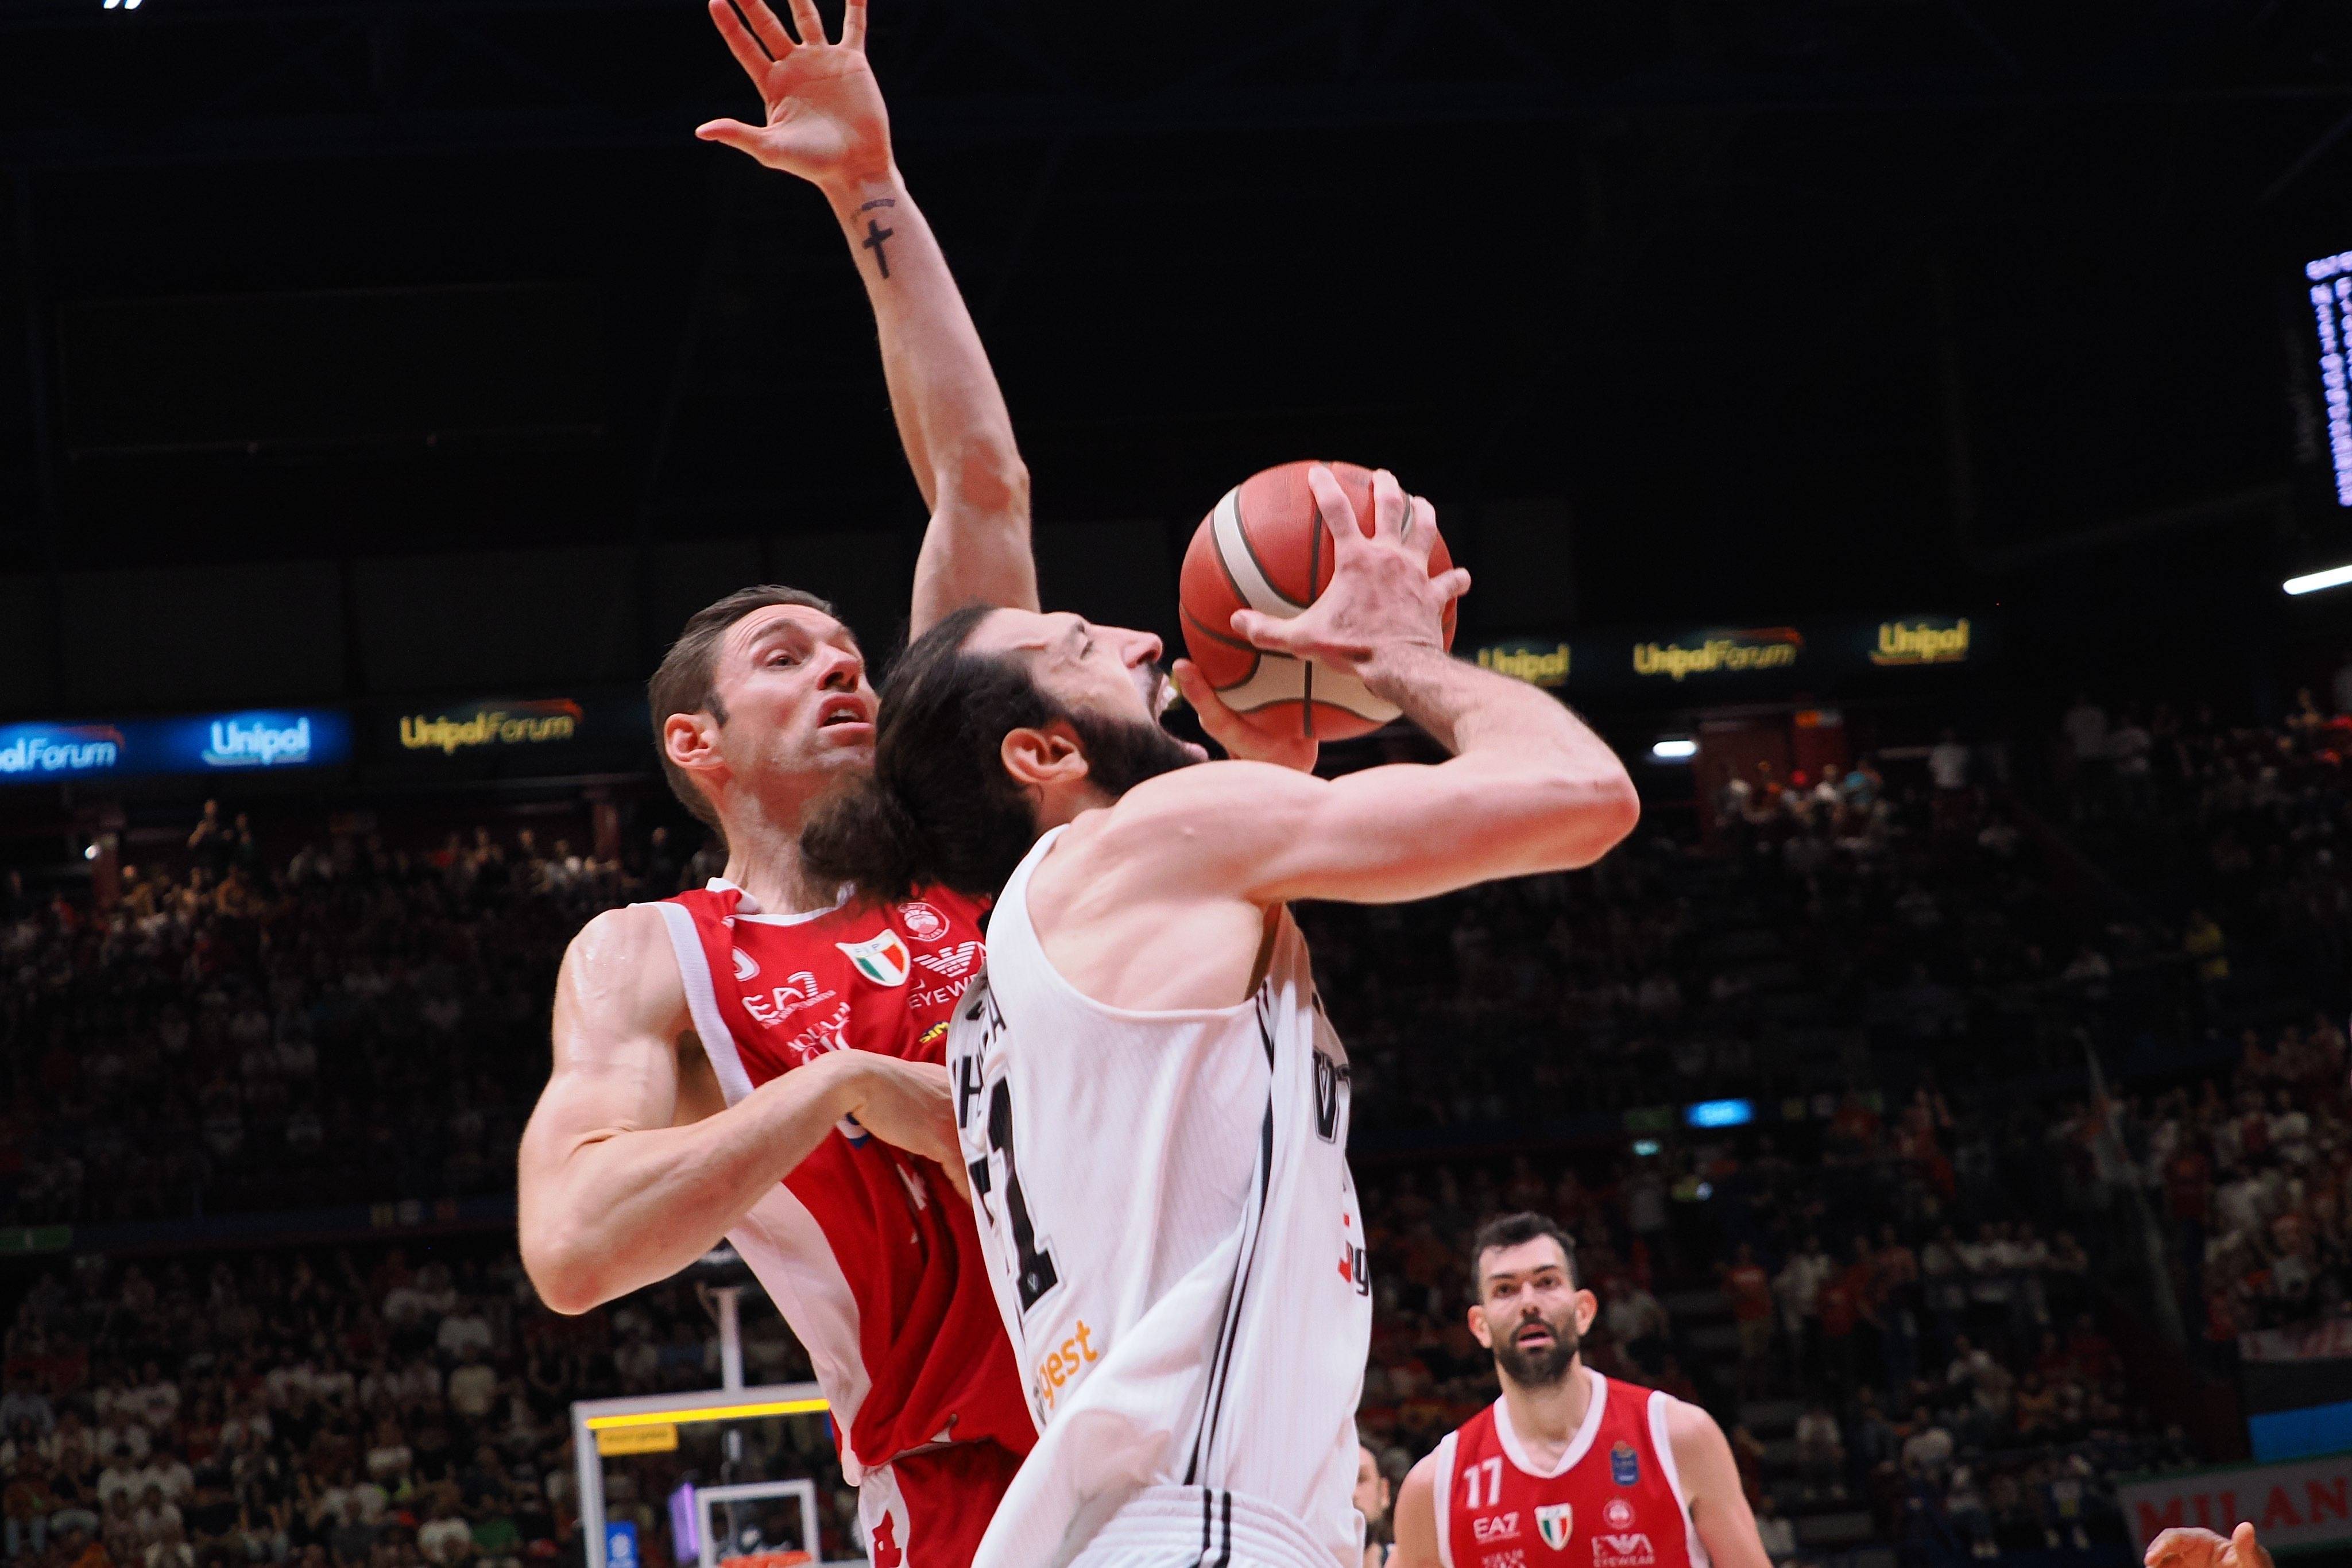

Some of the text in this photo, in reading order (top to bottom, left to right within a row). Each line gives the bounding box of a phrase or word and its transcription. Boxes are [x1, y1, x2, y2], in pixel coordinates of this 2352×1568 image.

[211, 717, 311, 765] Unipol
[400, 712, 574, 756] UnipolForum
[742, 971, 819, 1021] EA7
[1464, 1455, 1503, 1510] 17
[1473, 1512, 1521, 1540] EA7
